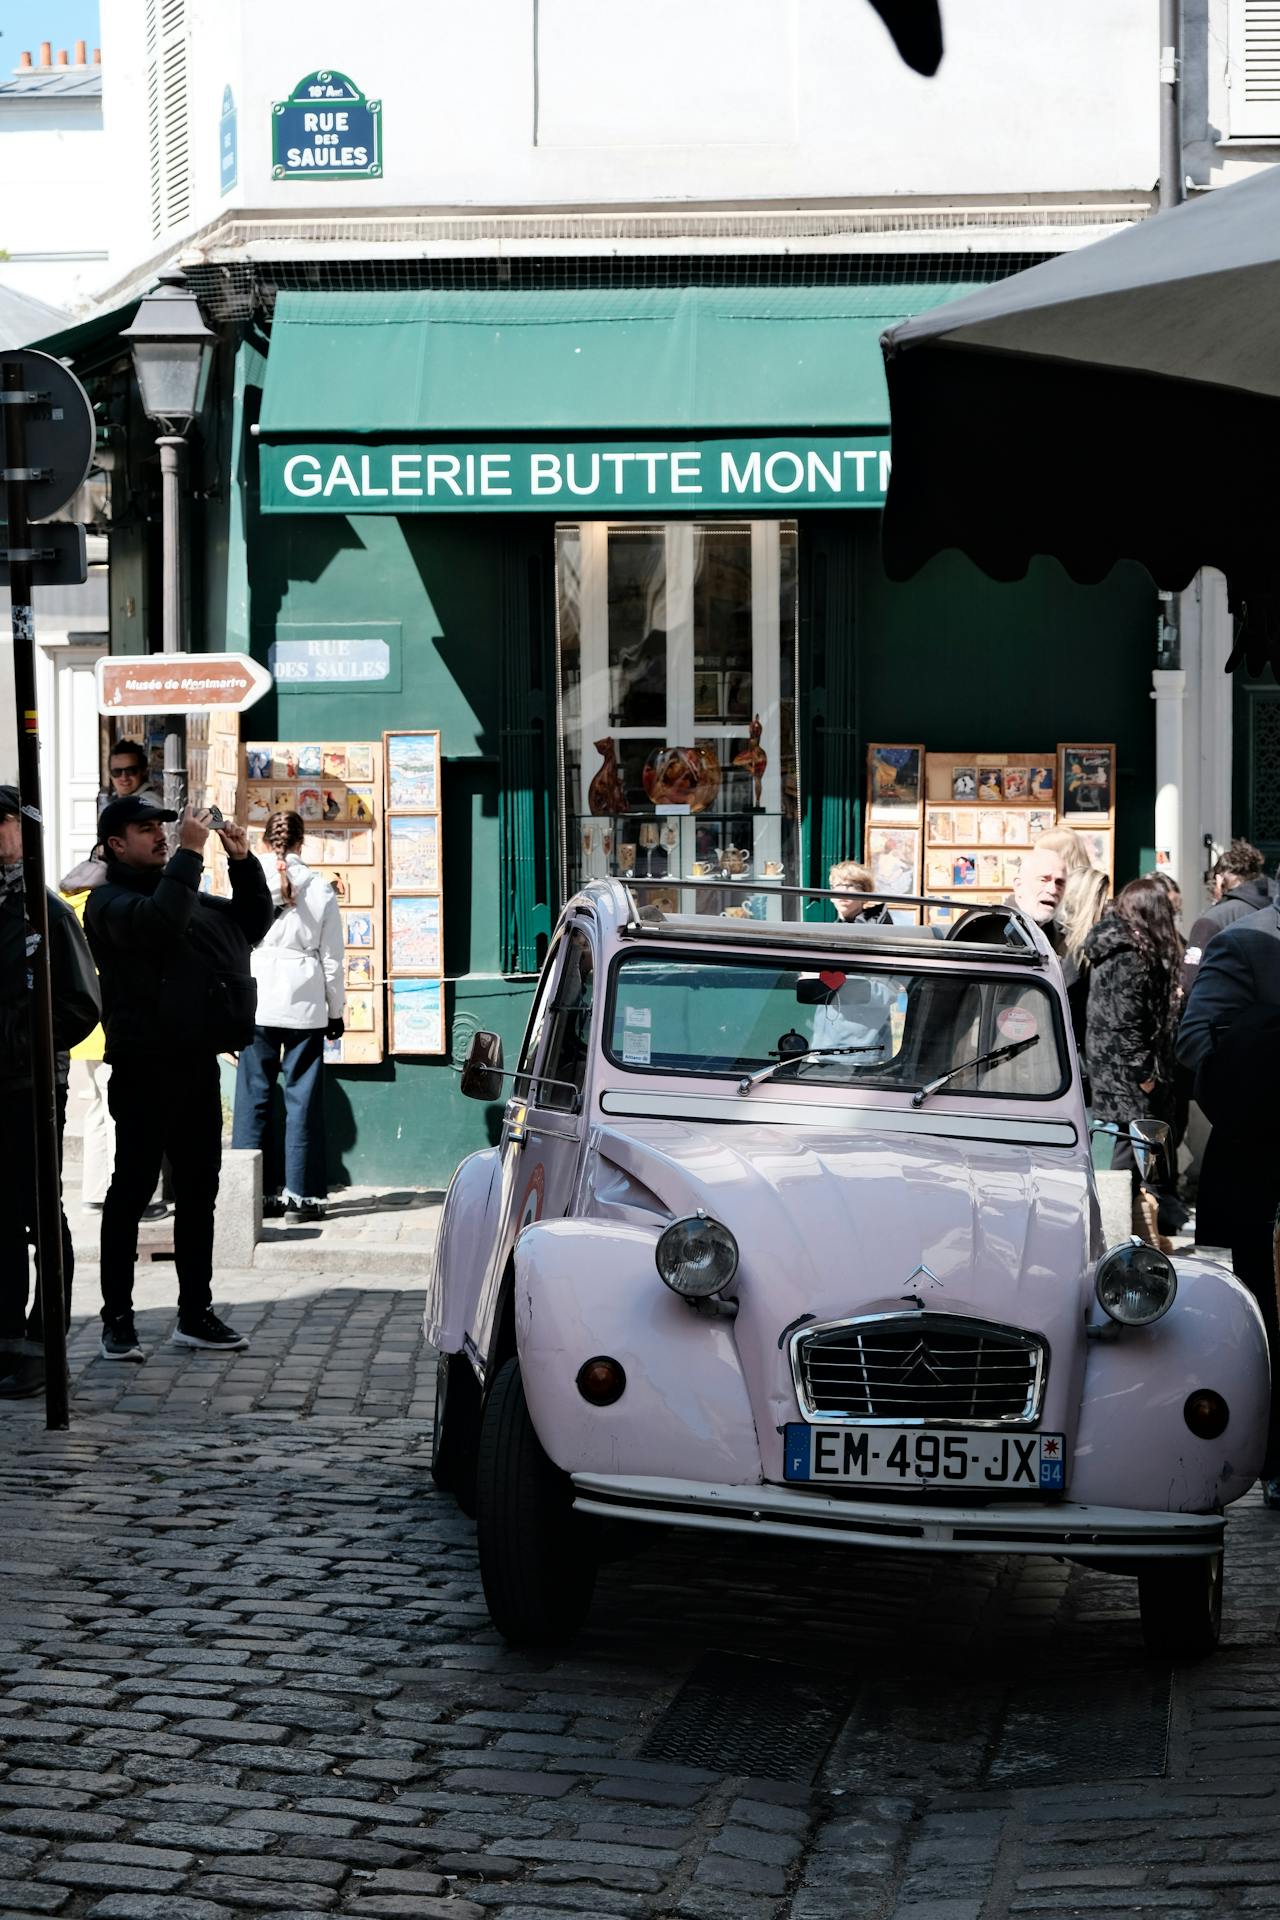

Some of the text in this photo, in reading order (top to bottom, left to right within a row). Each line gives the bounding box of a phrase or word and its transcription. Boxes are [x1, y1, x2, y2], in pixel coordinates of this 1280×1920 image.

[304, 112, 349, 131] RUE
[315, 134, 339, 145] DES
[287, 147, 368, 167] SAULES
[283, 454, 512, 497] GALERIE
[530, 451, 702, 496] BUTTE
[308, 639, 351, 656] RUE
[274, 661, 386, 678] DES SAULES
[125, 679, 162, 690] Musée
[164, 679, 179, 689] de
[793, 1431, 1062, 1483] F EM-495-JX 94
